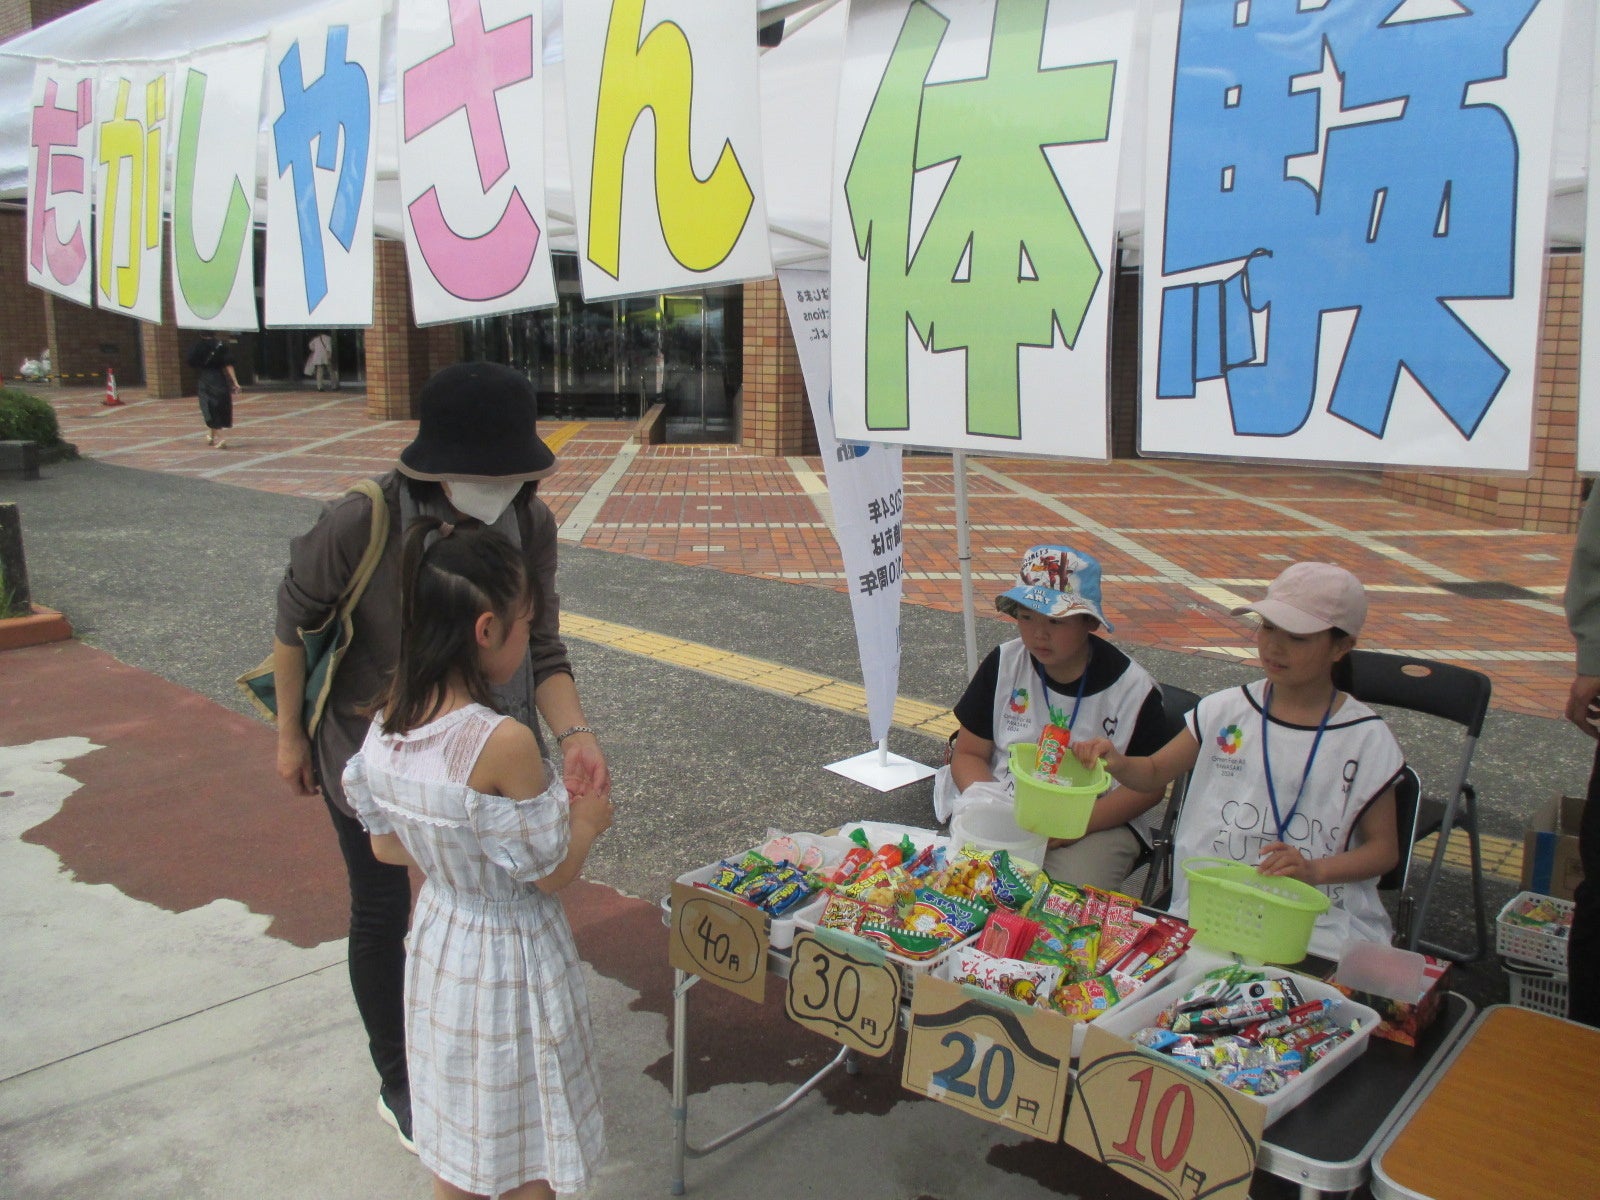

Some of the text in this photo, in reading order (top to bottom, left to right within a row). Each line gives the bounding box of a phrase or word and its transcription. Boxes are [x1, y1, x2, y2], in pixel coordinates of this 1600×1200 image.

[698, 915, 740, 972] 40円
[803, 953, 877, 1036] 30円
[932, 1030, 1040, 1126] 20円
[1112, 1066, 1207, 1196] 10円
